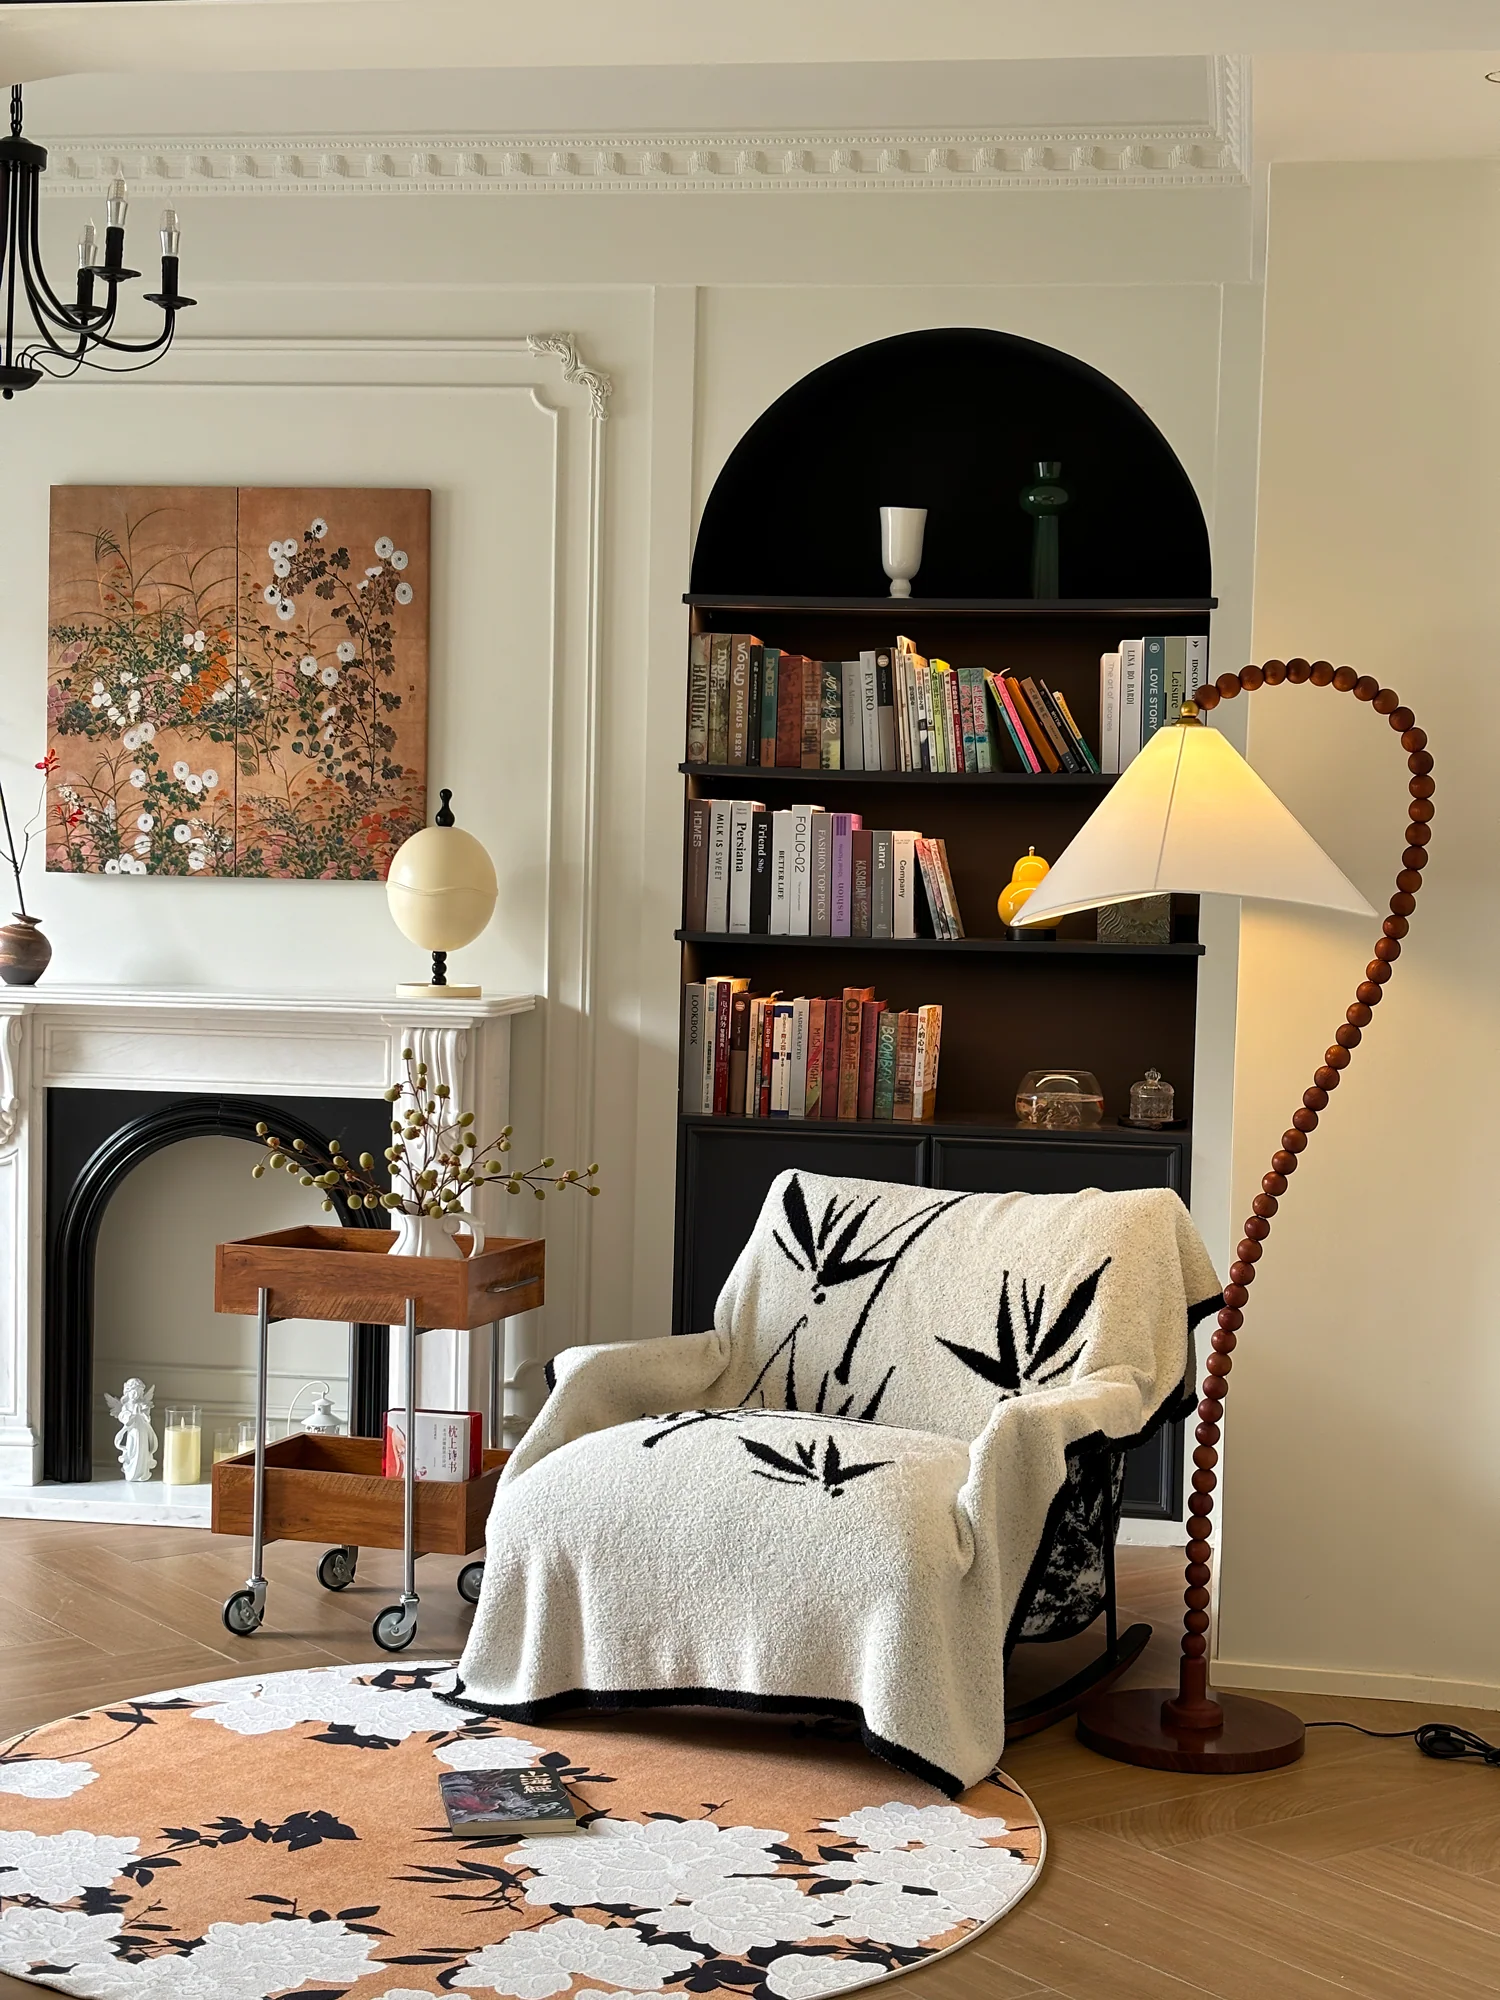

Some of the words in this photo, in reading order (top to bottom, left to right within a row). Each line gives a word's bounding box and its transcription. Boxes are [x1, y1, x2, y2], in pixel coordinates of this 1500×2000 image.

[717, 648, 727, 690] INDIE
[733, 642, 749, 686] WORLD
[765, 657, 775, 697] INDIE
[1127, 670, 1135, 680] BO
[1149, 668, 1159, 695] LOVE
[691, 663, 707, 732] BANQUET
[710, 664, 718, 706] NIGHT
[865, 673, 875, 711] EVERO
[1126, 683, 1135, 705] BARDI
[1171, 671, 1181, 709] Leisure
[1149, 697, 1158, 730] STORY
[693, 811, 702, 847] HOMES
[716, 814, 724, 836] MILK
[757, 824, 768, 856] Friend
[716, 840, 723, 848] IS
[736, 822, 747, 872] Persiana
[794, 816, 806, 873] FOLIO-02
[818, 830, 826, 870] FASHION
[715, 852, 723, 880] SWEET
[757, 858, 765, 873] Ship
[818, 873, 826, 893] TOP
[898, 859, 907, 898] Company
[817, 894, 826, 921] PICKS
[836, 882, 844, 922] Fashion
[690, 994, 699, 1045] LOOKBOOK
[845, 998, 860, 1035] OLD
